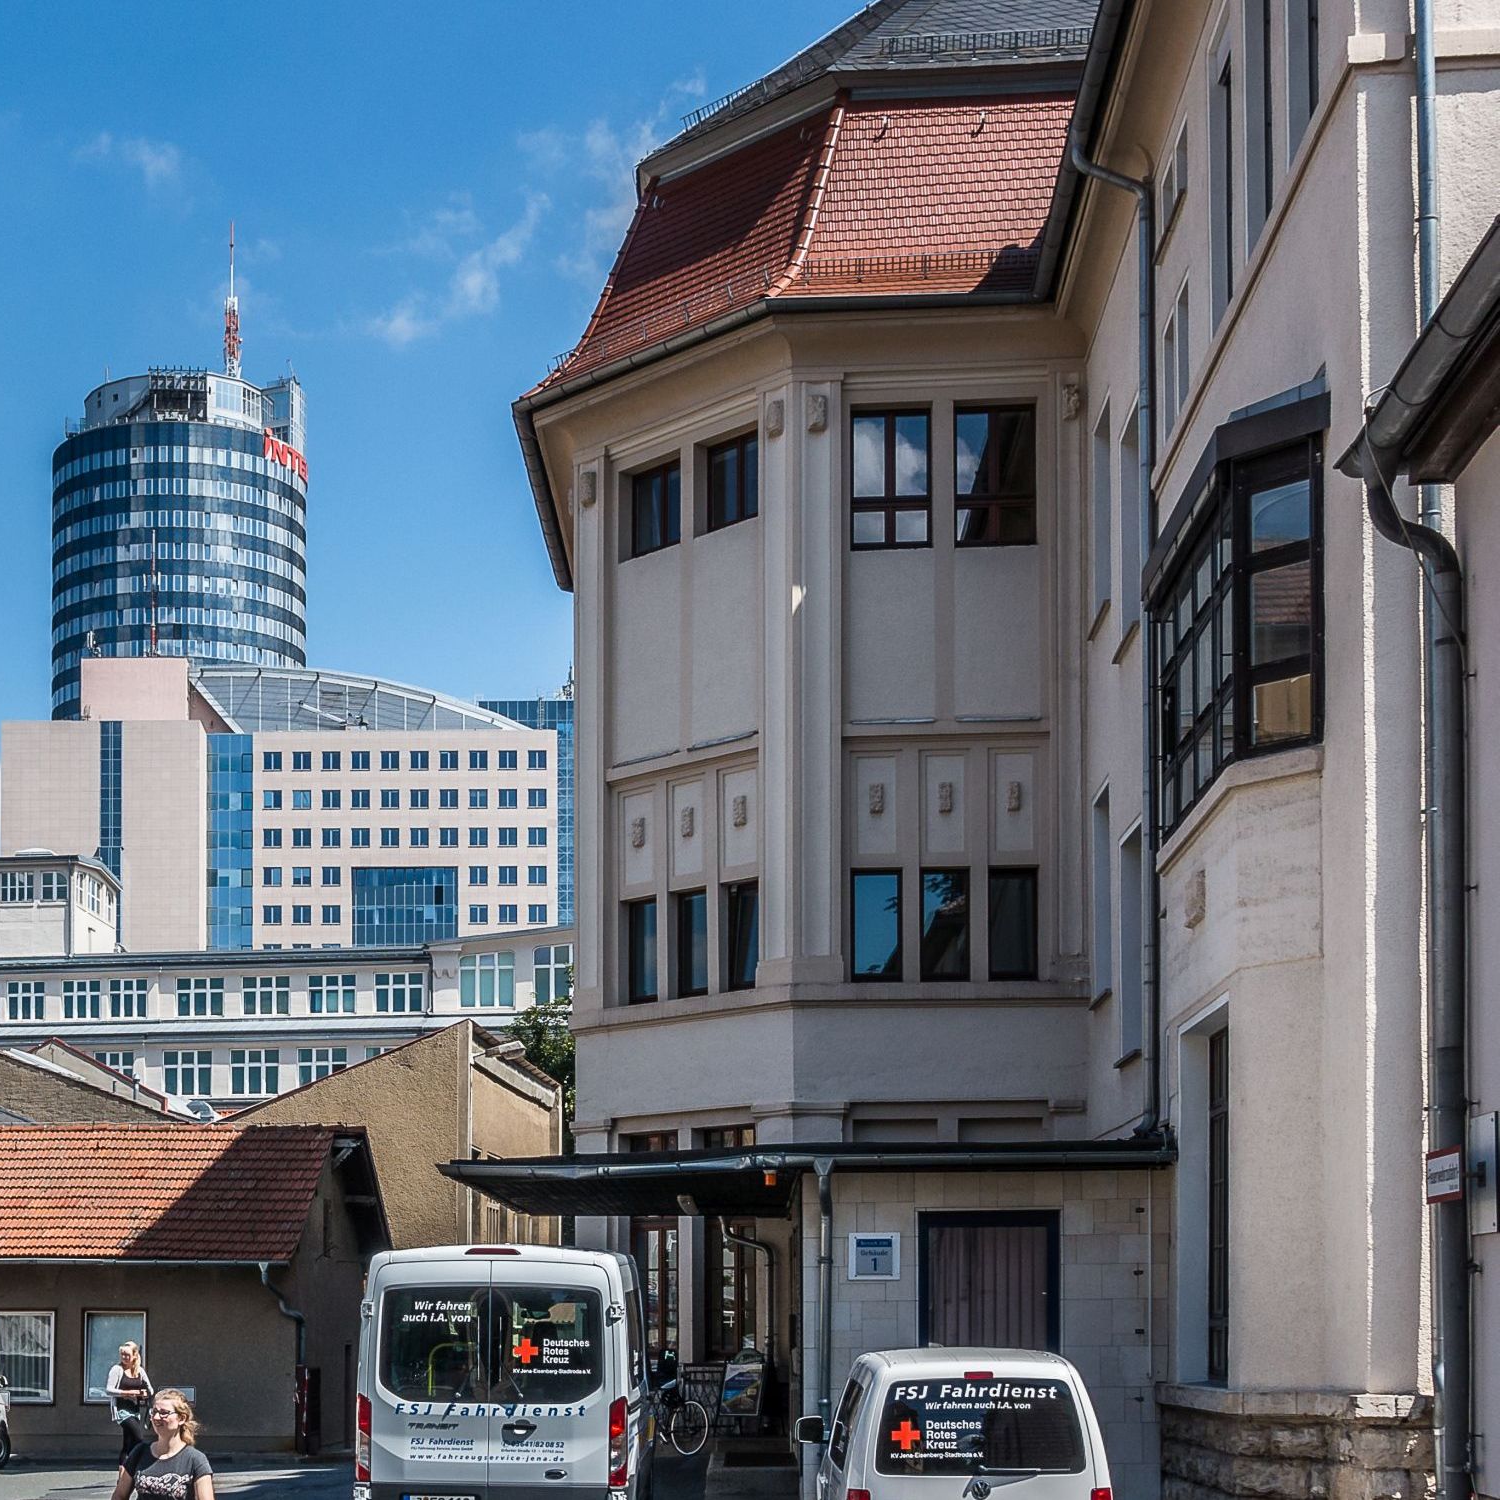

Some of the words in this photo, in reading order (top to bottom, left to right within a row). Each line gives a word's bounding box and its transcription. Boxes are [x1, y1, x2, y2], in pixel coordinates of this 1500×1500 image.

[871, 1257, 877, 1271] 1
[414, 1301, 434, 1310] Wir
[435, 1301, 472, 1310] fahren
[402, 1313, 428, 1322] auch
[430, 1313, 448, 1322] i.A.
[451, 1314, 471, 1322] von
[543, 1338, 590, 1347] Deutsches
[543, 1347, 570, 1355] Rotes
[543, 1356, 570, 1364] Kreuz
[894, 1385, 929, 1400] FSJ
[939, 1383, 1058, 1399] Fahrdienst
[395, 1403, 433, 1415] FSJ
[446, 1403, 586, 1417] Fahrdienst
[925, 1402, 941, 1410] Wir
[942, 1401, 972, 1410] fahren
[974, 1401, 996, 1409] auch
[997, 1401, 1012, 1409] i.A.
[407, 1422, 460, 1430] TRANSIT
[926, 1420, 982, 1430] Deutsches
[926, 1430, 957, 1439] Rotes
[411, 1437, 425, 1445] FSJ
[428, 1438, 475, 1446] Fahrdienst
[926, 1440, 958, 1449] Kreuz
[409, 1453, 565, 1462] www.fahrzeugservice-jena.de
[899, 1451, 972, 1460] Jena-Eisenberg-Stadtroda
